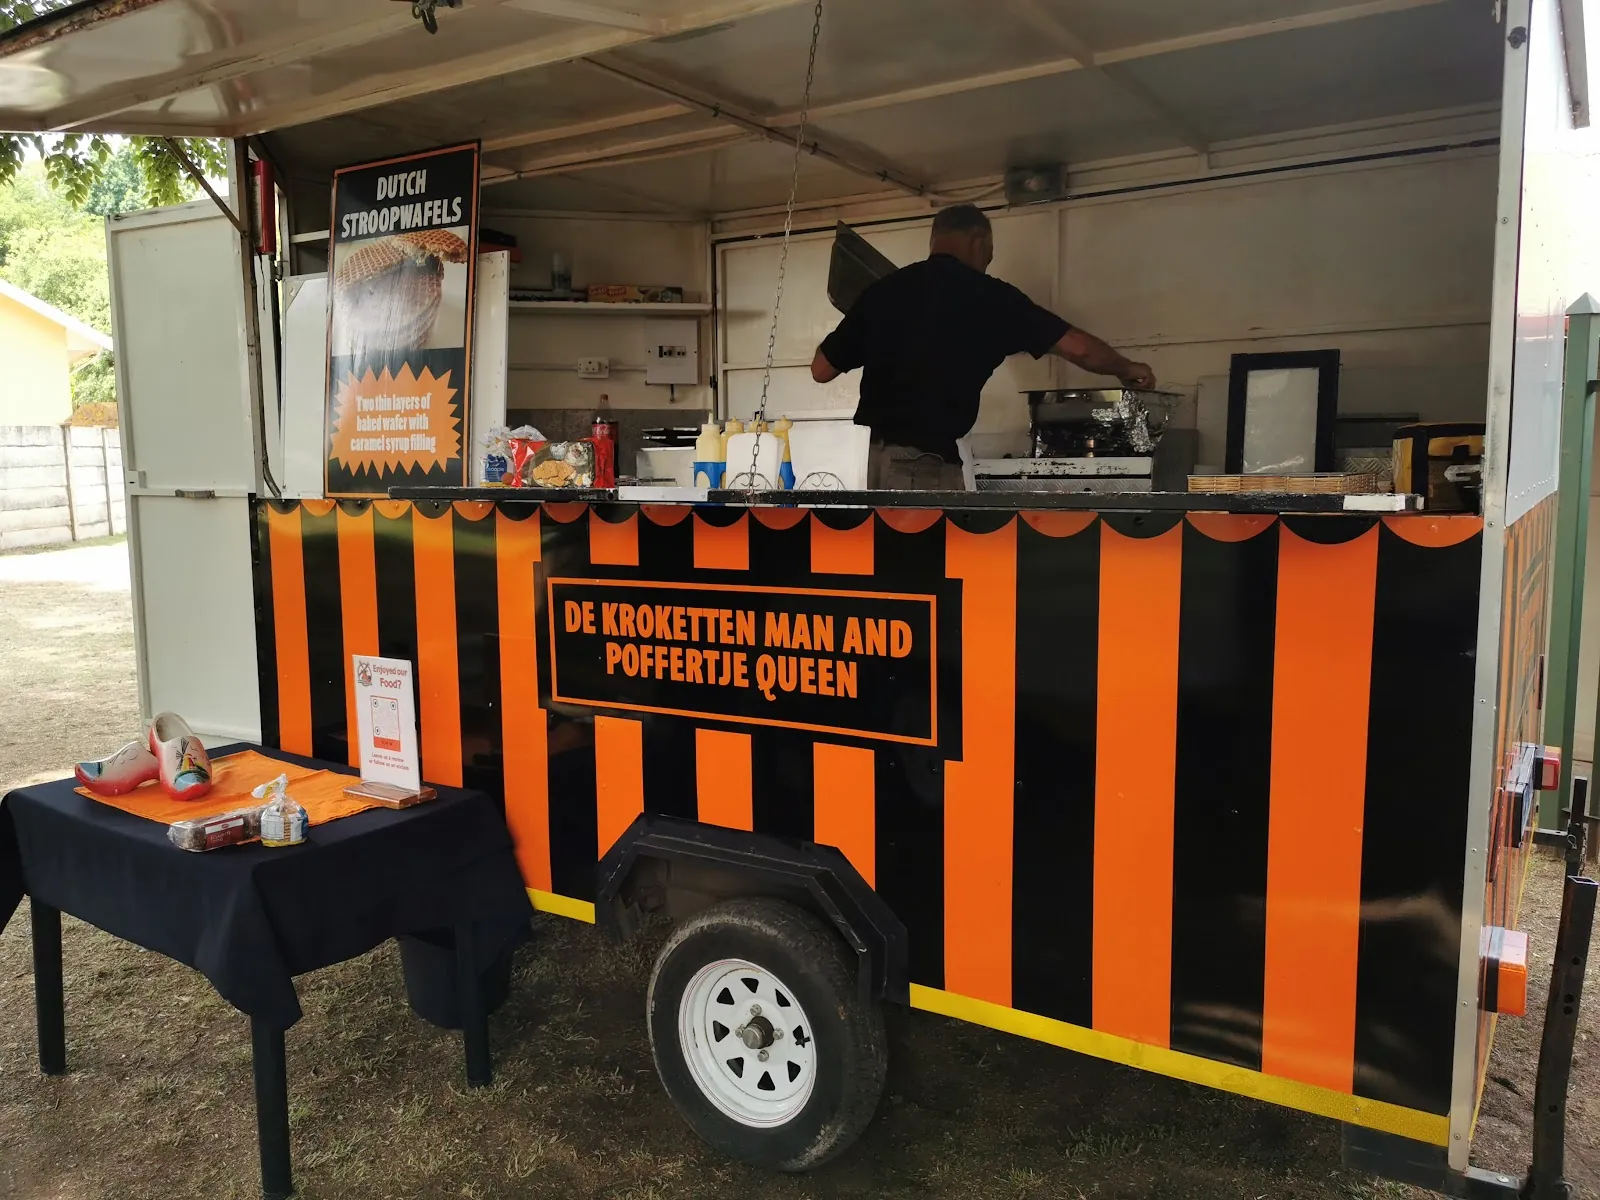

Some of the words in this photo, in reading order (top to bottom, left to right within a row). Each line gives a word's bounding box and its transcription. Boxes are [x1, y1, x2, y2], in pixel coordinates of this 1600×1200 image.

[377, 169, 427, 200] DUTCH
[341, 197, 462, 238] STROOPWAFELS
[356, 395, 375, 411] Two
[375, 394, 392, 411] thin
[393, 394, 420, 413] layers
[421, 392, 432, 409] of
[357, 415, 381, 432] baked
[383, 414, 408, 431] wafer
[409, 413, 429, 430] with
[351, 434, 385, 451] caramel
[386, 436, 409, 454] syrup
[411, 433, 436, 453] filling
[564, 600, 597, 634] DE
[602, 602, 756, 646] KROKETTEN
[764, 611, 834, 652] MAN
[842, 617, 913, 658] AND
[373, 664, 396, 676] Enjoyed
[606, 642, 749, 688] POFFERTJE
[756, 654, 858, 701] QUEEN
[380, 678, 402, 689] Food?
